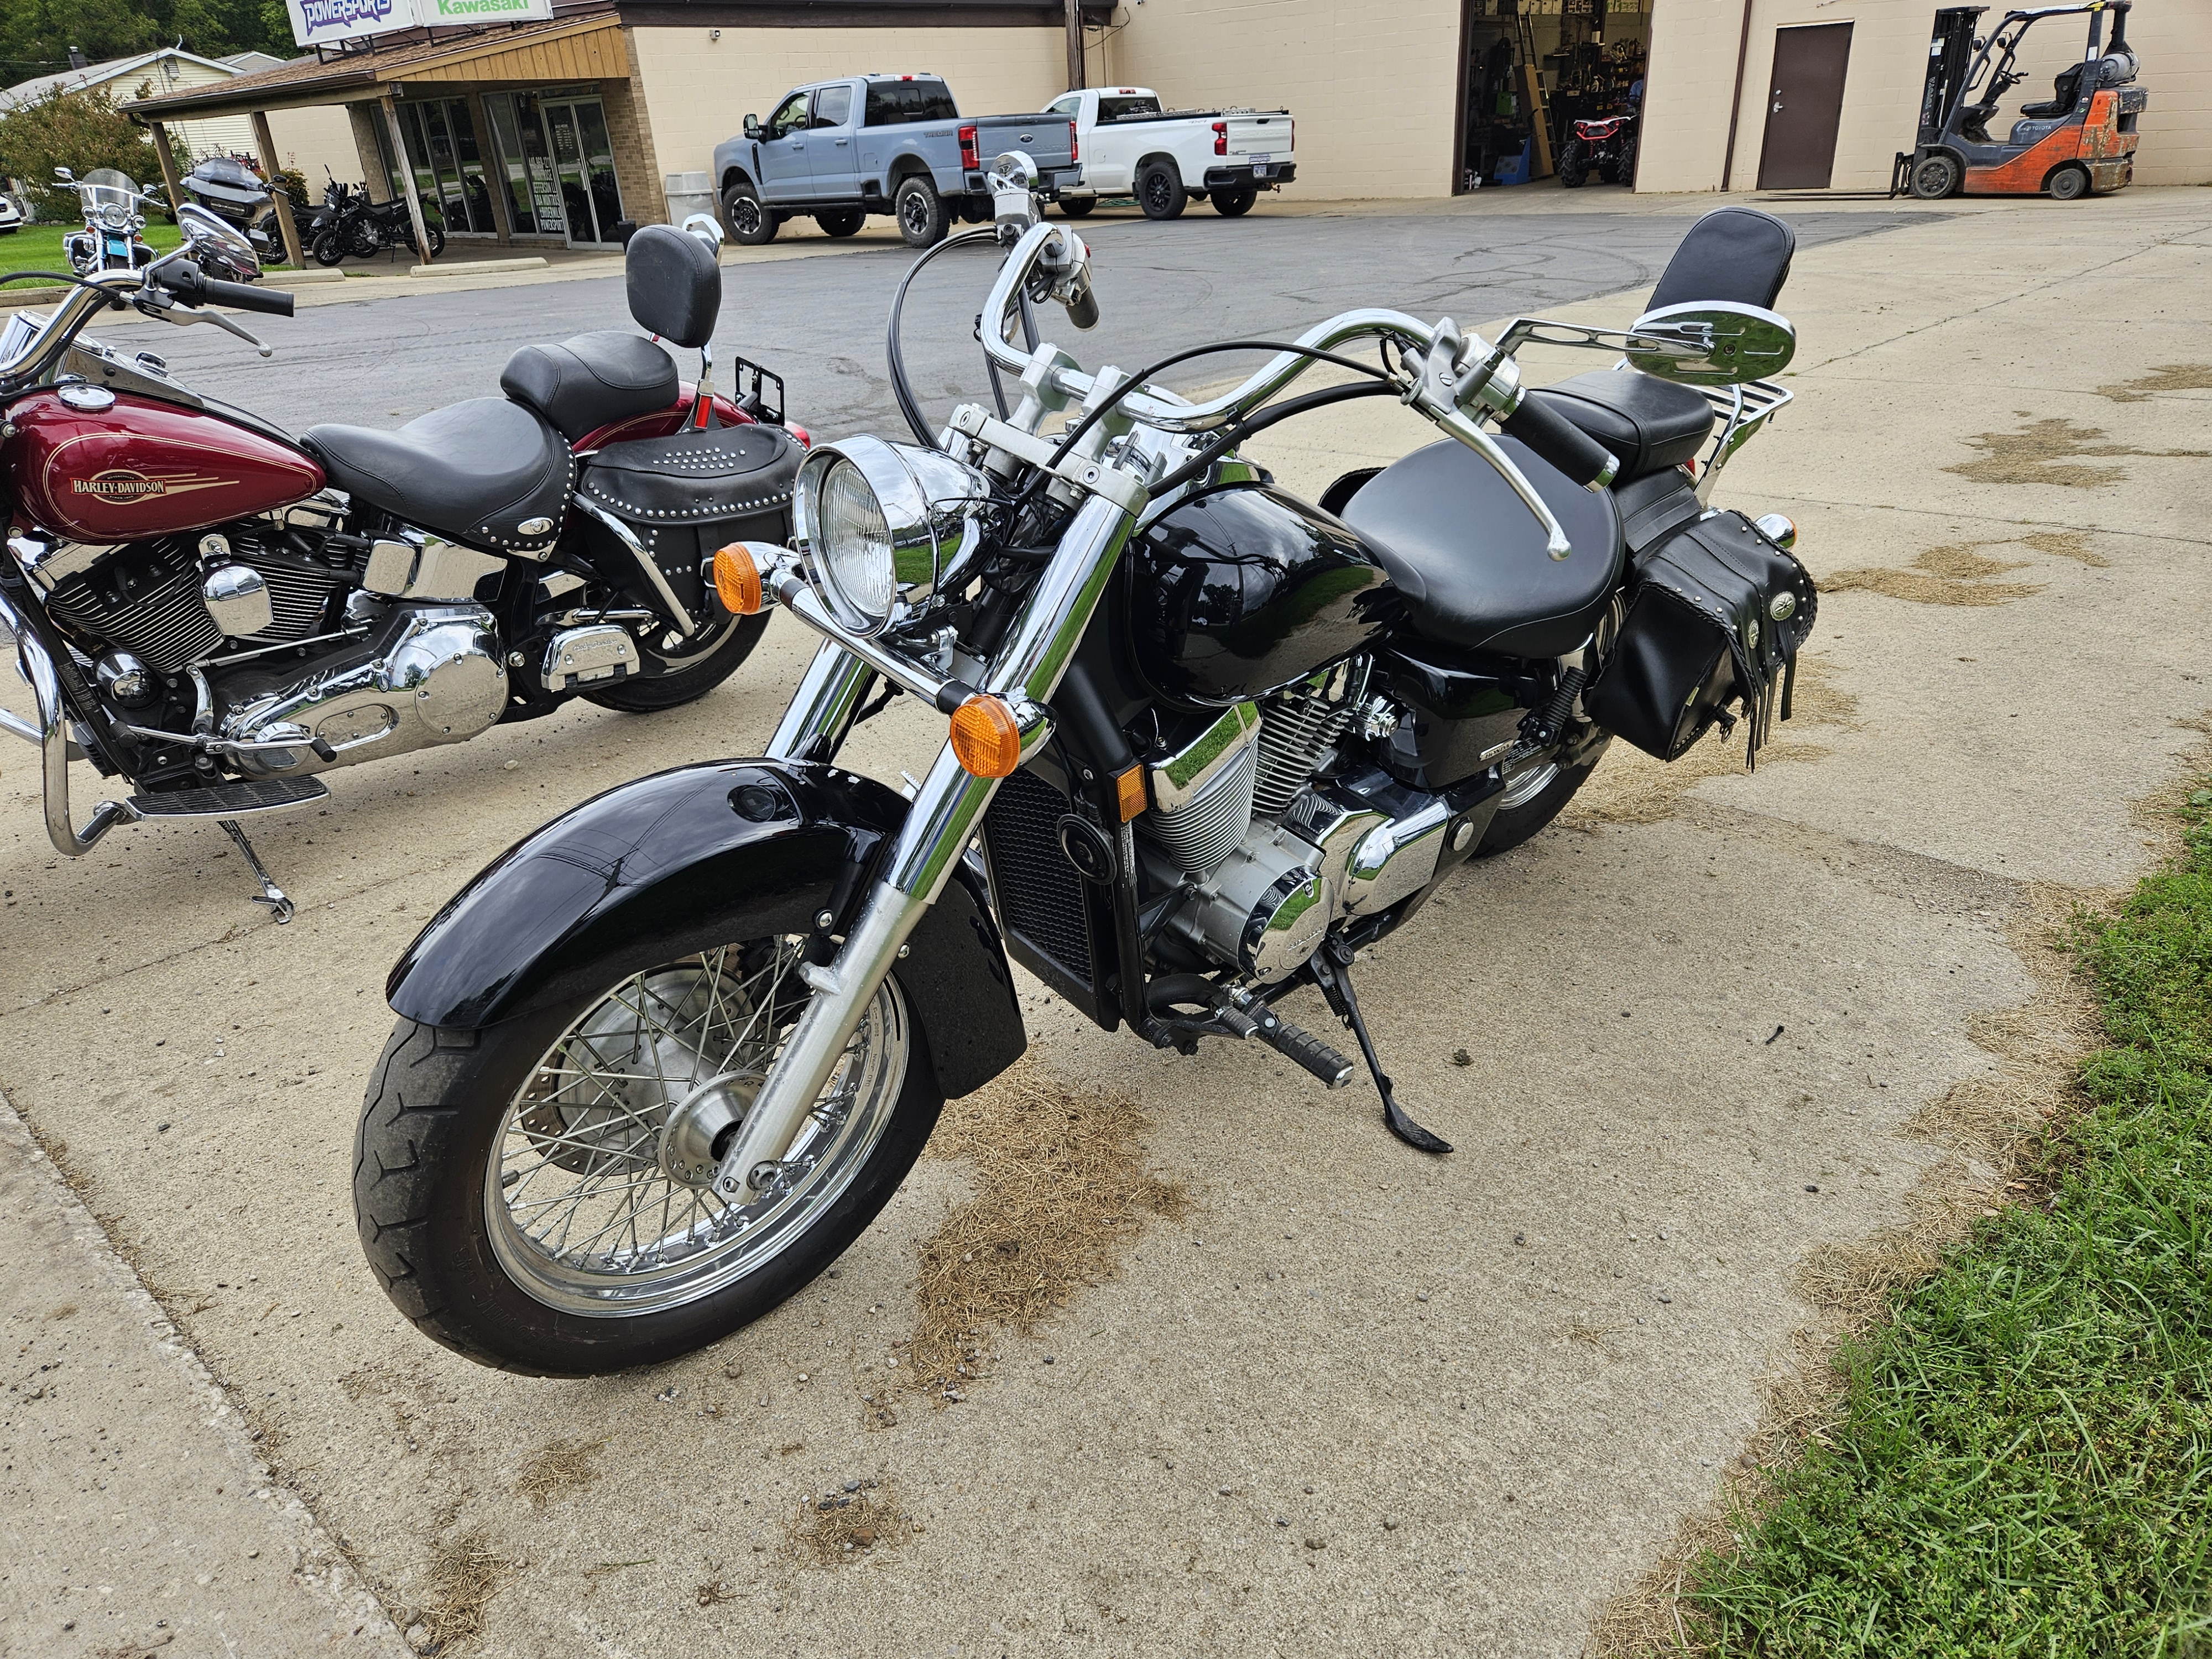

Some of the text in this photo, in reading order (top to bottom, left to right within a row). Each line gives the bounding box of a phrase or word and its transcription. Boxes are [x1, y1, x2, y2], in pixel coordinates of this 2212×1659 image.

[1925, 77, 1936, 109] TOYOTA
[923, 130, 953, 138] TREMOR
[1485, 744, 1510, 758] HONDA
